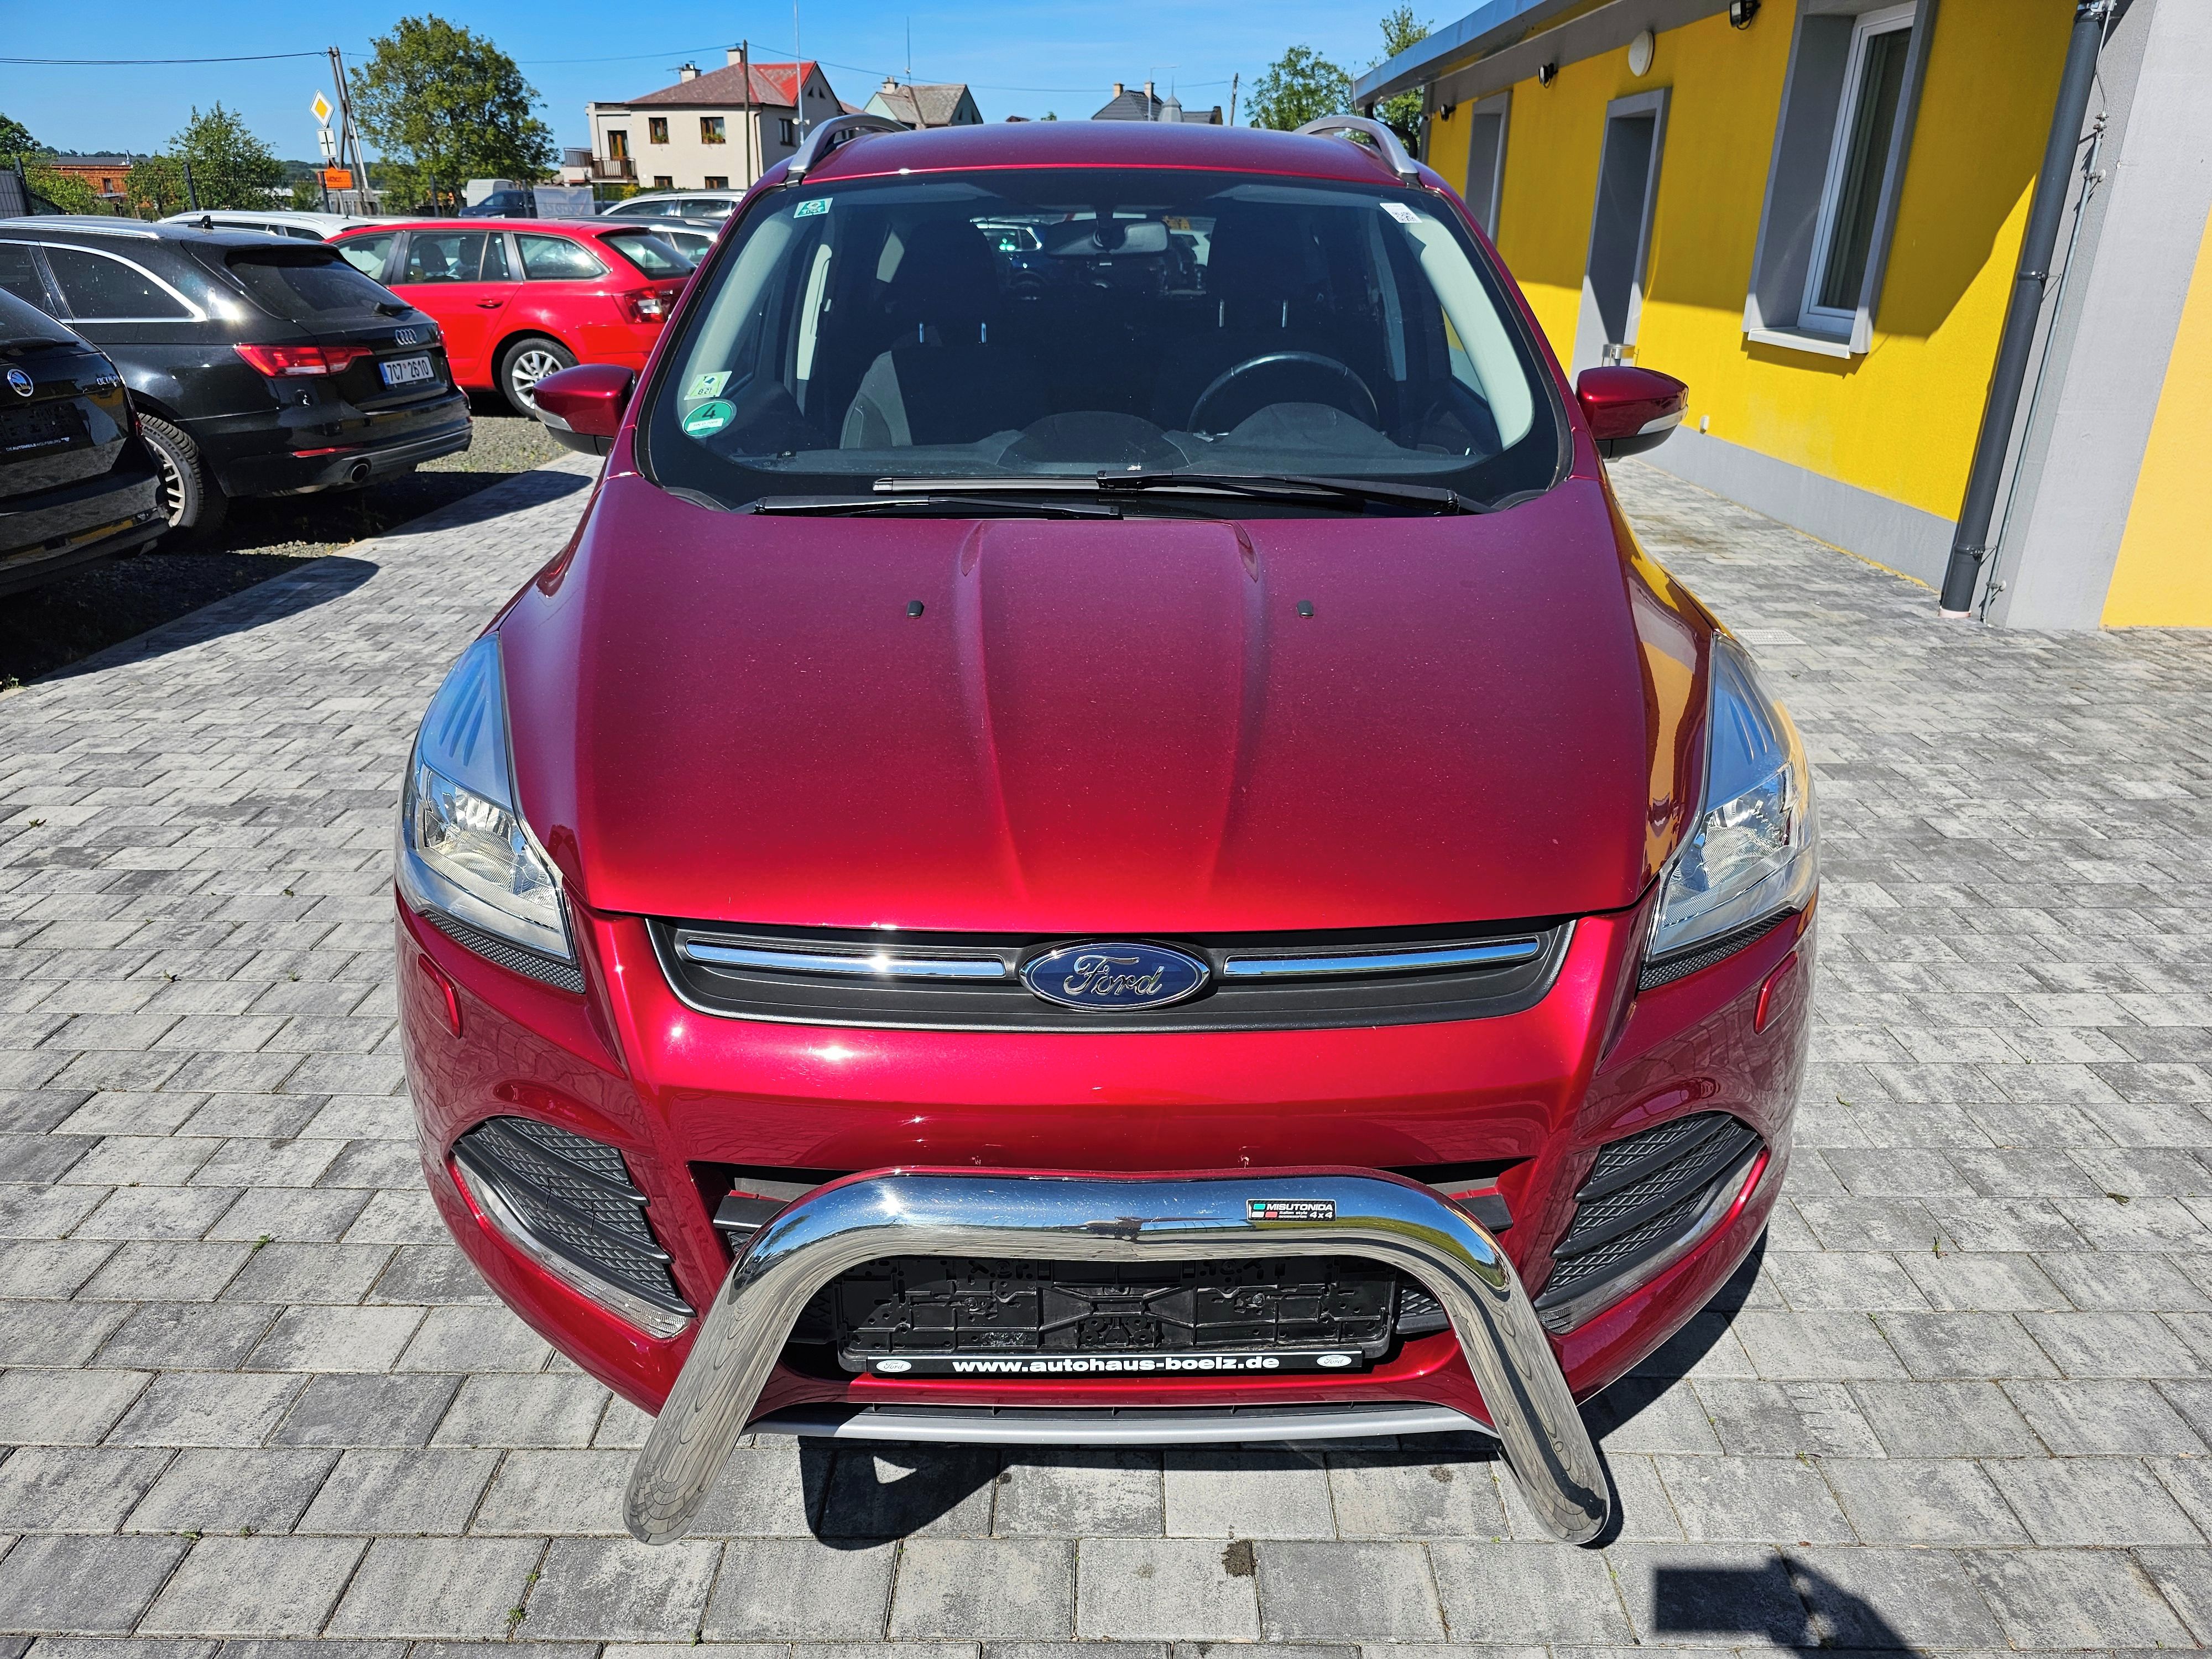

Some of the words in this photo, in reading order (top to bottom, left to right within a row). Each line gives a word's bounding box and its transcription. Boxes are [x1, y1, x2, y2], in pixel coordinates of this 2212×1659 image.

[386, 363, 403, 382] 7C7
[408, 359, 429, 378] 2610
[702, 404, 717, 419] 4
[1063, 954, 1165, 996] Ford
[952, 1357, 1280, 1372] www.autohaus-boelz.de
